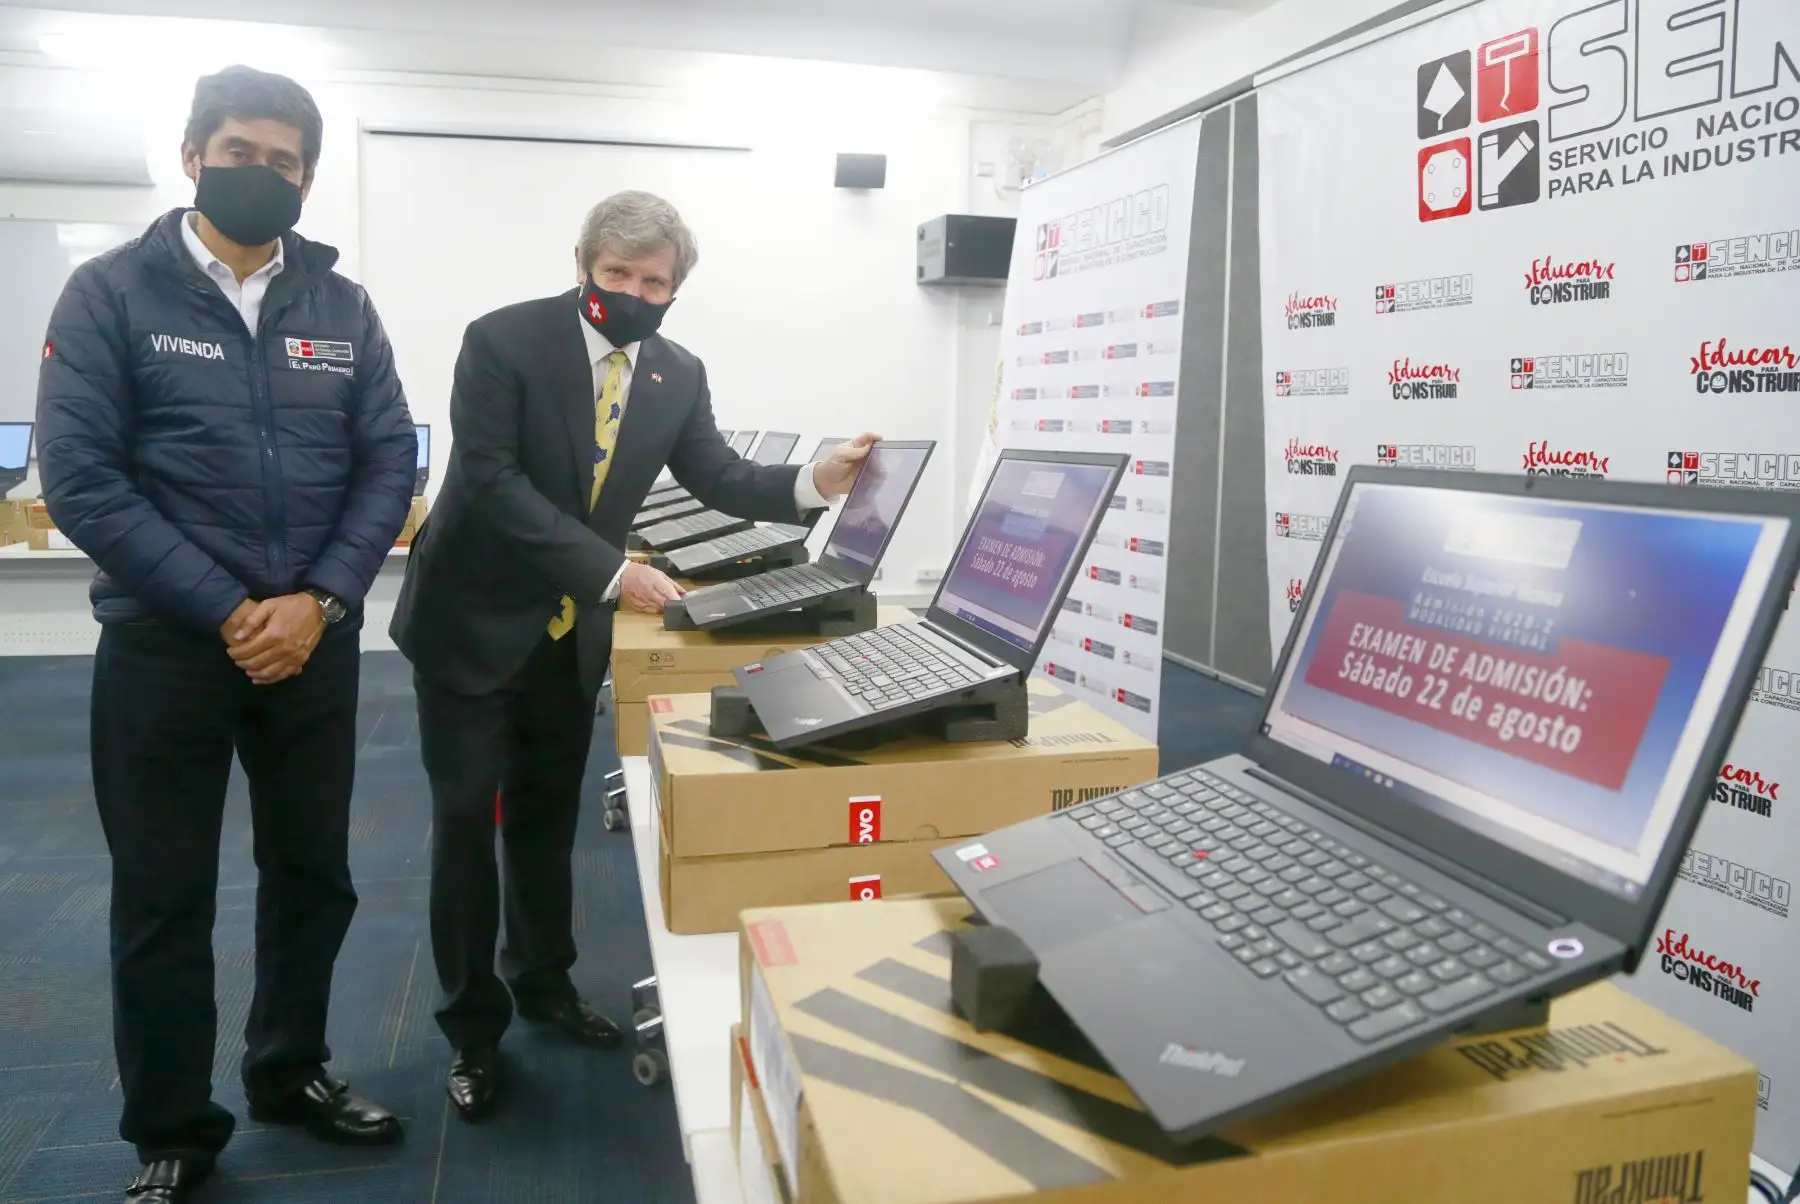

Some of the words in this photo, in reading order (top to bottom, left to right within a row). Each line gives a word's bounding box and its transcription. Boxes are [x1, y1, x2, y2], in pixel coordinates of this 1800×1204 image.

[1548, 126, 1668, 172] SERVICIO
[1548, 168, 1614, 199] PARA
[1622, 160, 1655, 186] LA
[1531, 256, 1609, 286] Educar
[1395, 274, 1473, 303] SENCICO
[1530, 281, 1610, 305] CONSTRUIR
[1288, 312, 1335, 330] CONSTRUIR
[151, 333, 225, 361] VIVIENDA
[1699, 338, 1800, 370] Educar
[1394, 357, 1454, 382] Educar
[1535, 352, 1628, 379] SENCICO
[1393, 383, 1457, 400] CONSTRUIR
[1288, 459, 1336, 476] CONSTRUIR
[1397, 444, 1475, 466] SENCICO
[1528, 440, 1602, 471] Educar
[1348, 622, 1427, 664] EXAMEN
[1428, 642, 1459, 674] DE
[1459, 650, 1592, 712] ADMISIÓN:
[1338, 651, 1414, 699] Sábado
[1416, 674, 1449, 710] 22
[1450, 684, 1483, 721] de
[1487, 702, 1582, 754] agosto
[1664, 928, 1752, 989] Educar
[1660, 953, 1753, 1013] CONSTRUIR
